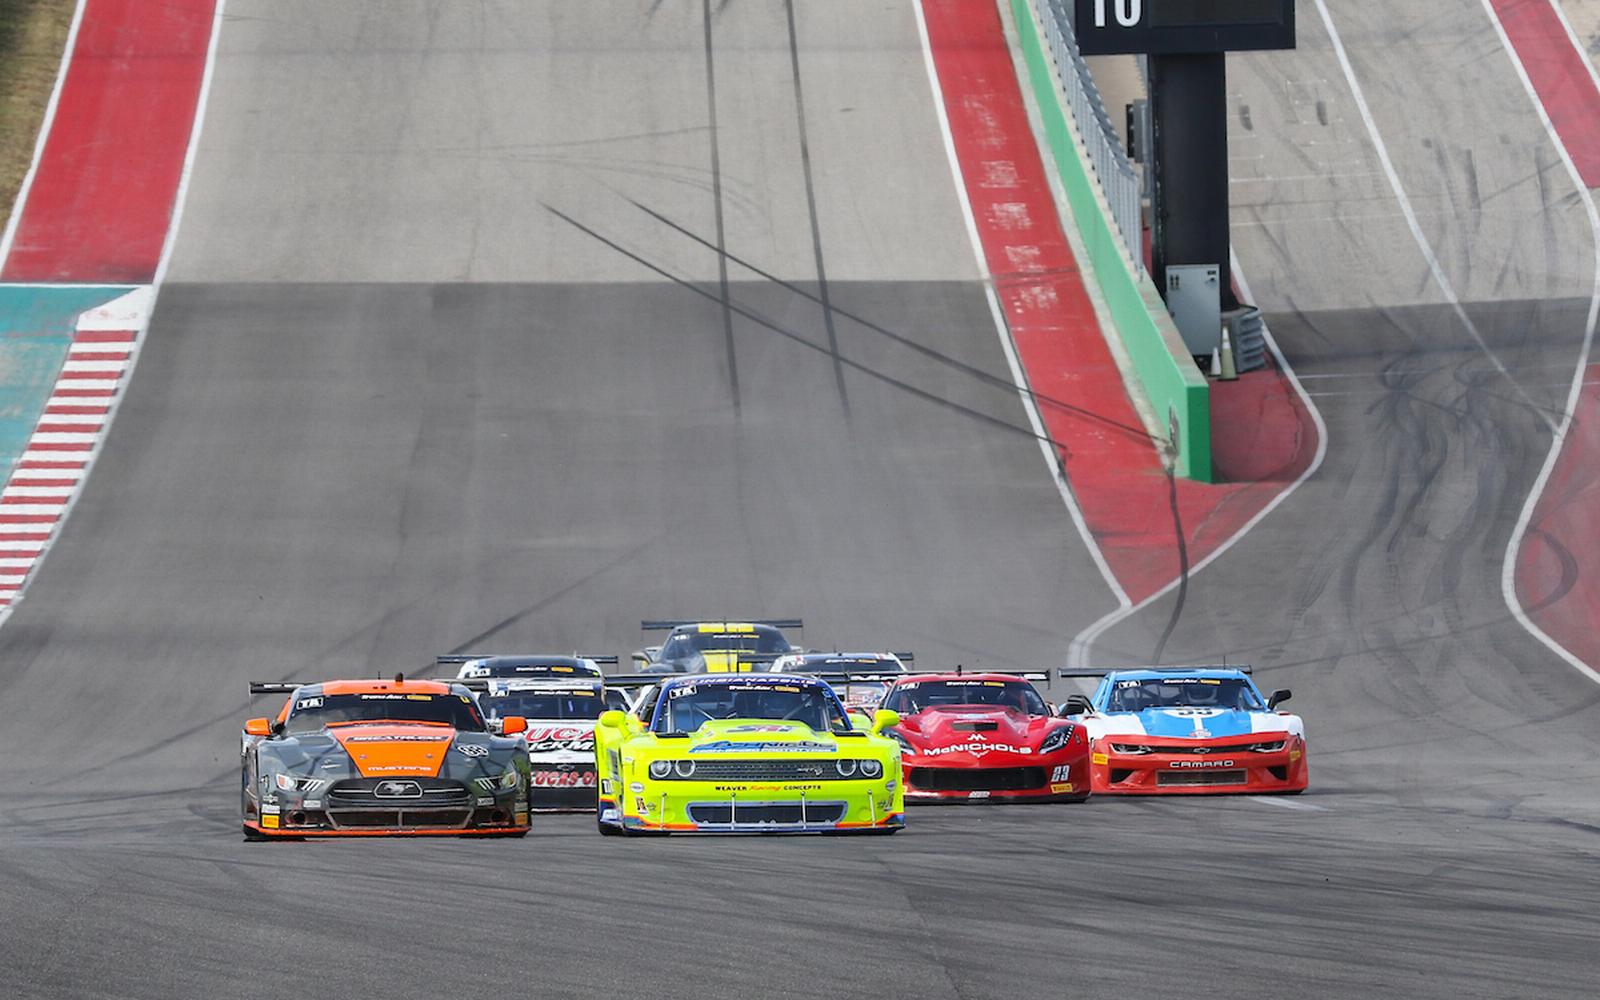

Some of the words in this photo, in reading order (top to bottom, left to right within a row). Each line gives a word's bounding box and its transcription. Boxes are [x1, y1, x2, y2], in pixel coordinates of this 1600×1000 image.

[674, 687, 693, 698] TA
[301, 699, 320, 709] TA
[525, 728, 594, 741] UCA
[1170, 760, 1234, 768] CAMARO
